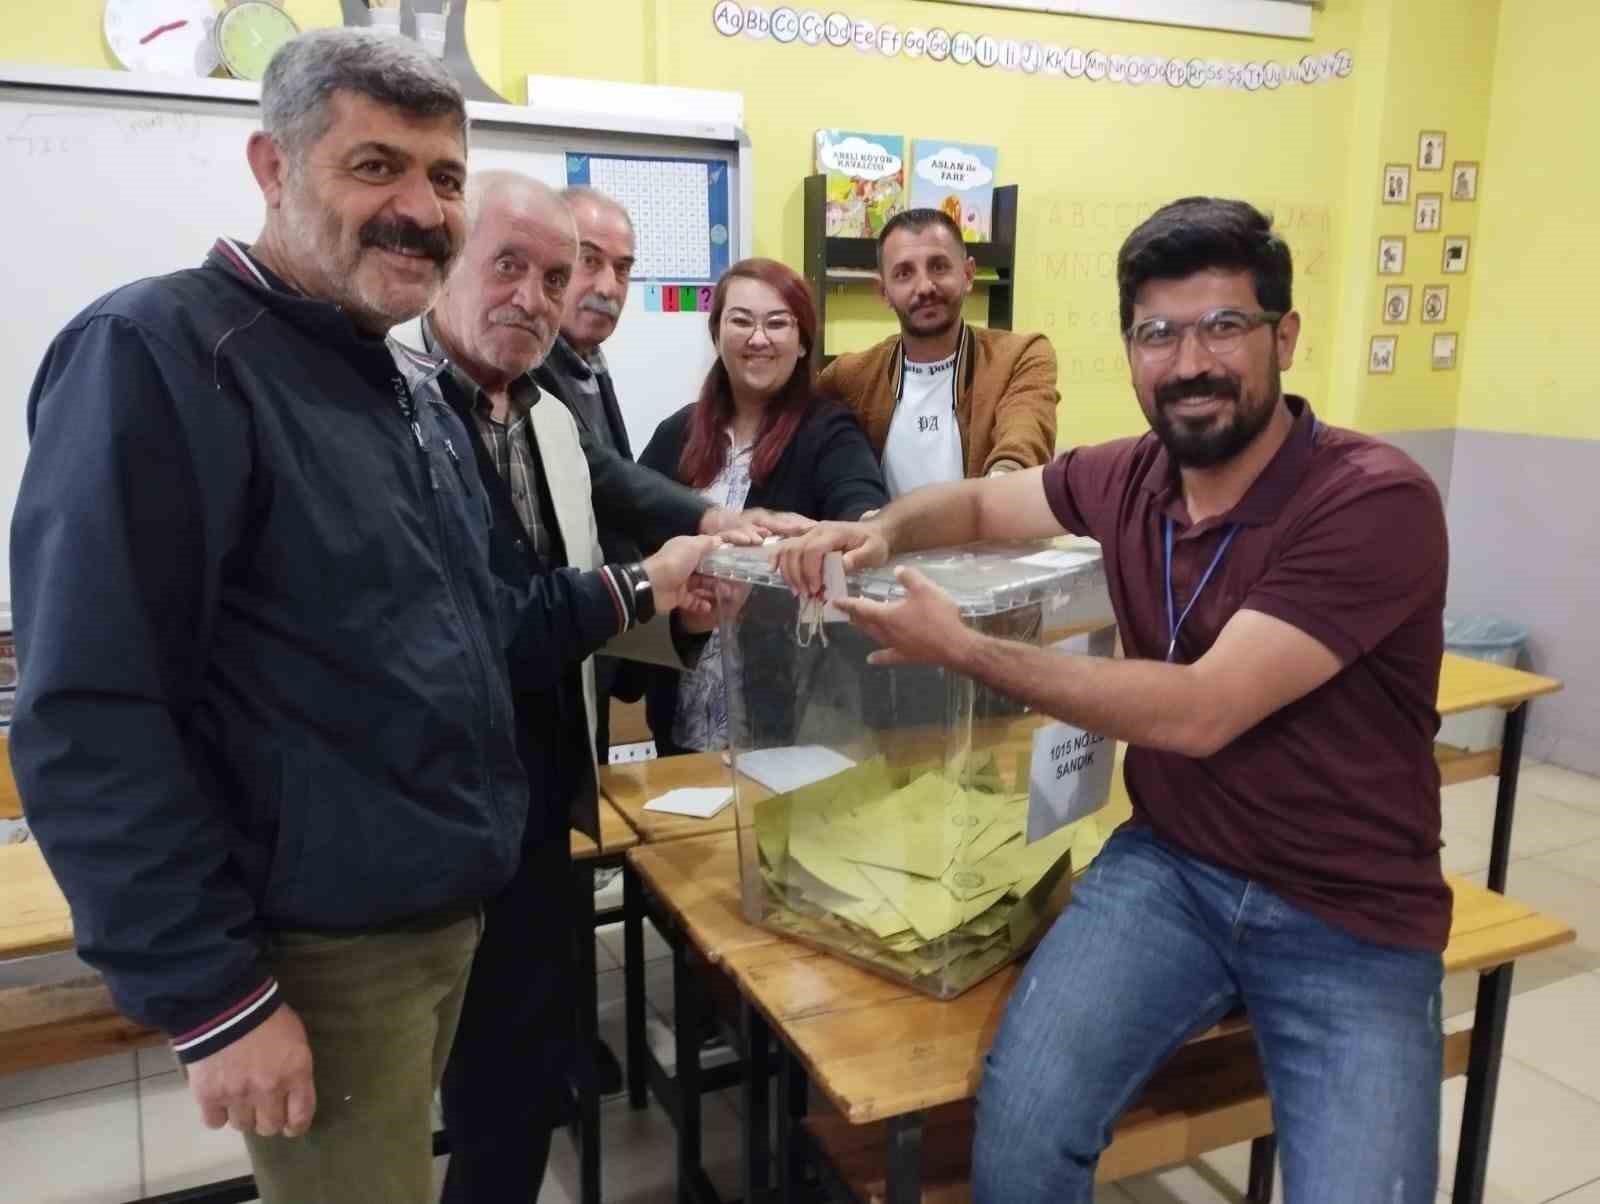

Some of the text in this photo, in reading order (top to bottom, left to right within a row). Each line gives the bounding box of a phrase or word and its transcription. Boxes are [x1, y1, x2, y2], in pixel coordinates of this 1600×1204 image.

[717, 7, 740, 28] Aa
[746, 10, 769, 32] Bb
[775, 13, 796, 32] Cc
[828, 20, 848, 38] Dd
[854, 24, 874, 44] Ee
[880, 30, 899, 50] Ff
[931, 159, 963, 171] ASLAN
[917, 415, 939, 433] PA
[1050, 740, 1072, 762] 1015
[1055, 751, 1095, 780] SANDIK
